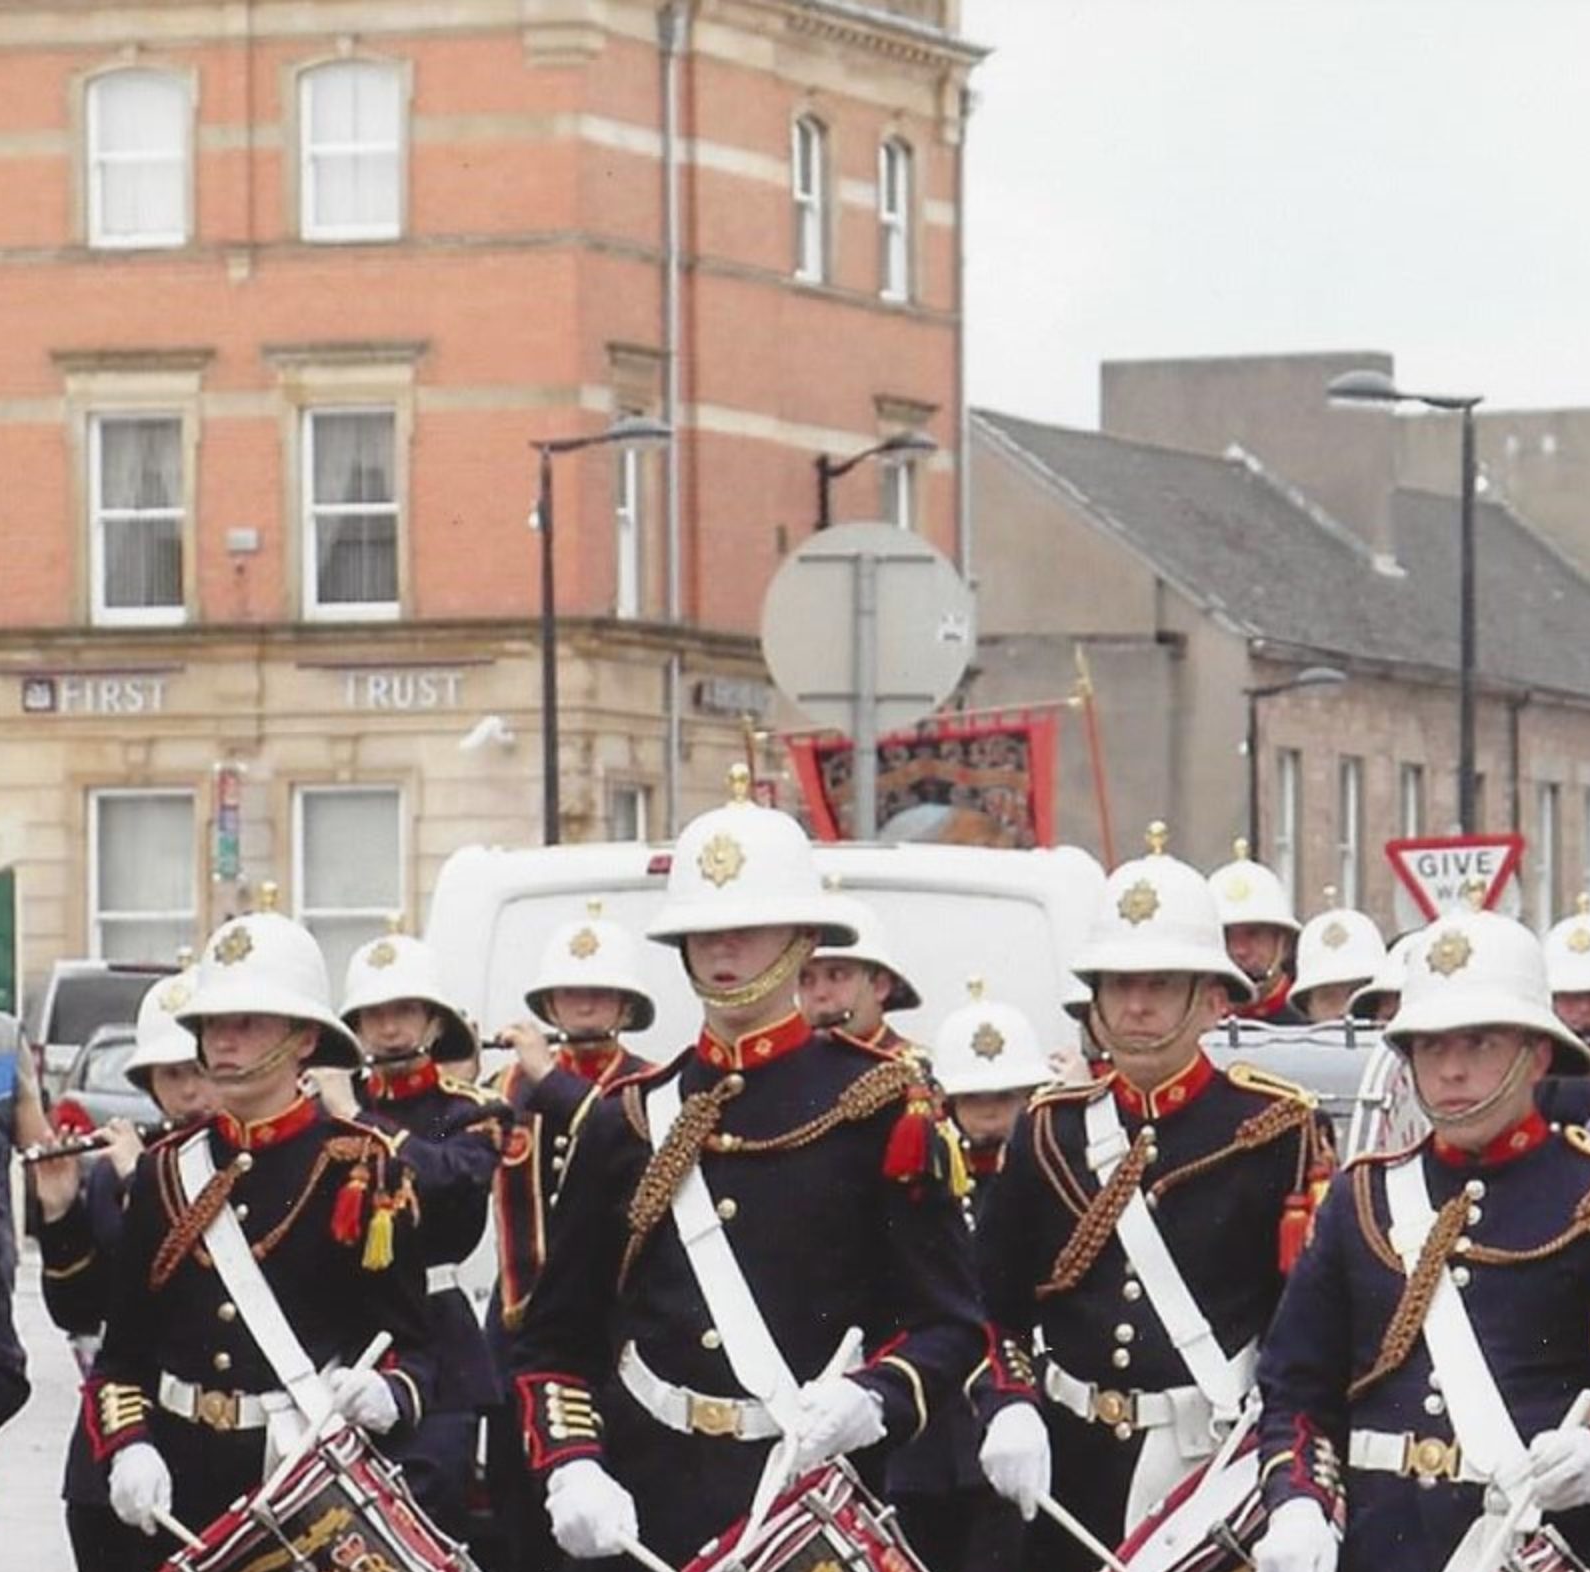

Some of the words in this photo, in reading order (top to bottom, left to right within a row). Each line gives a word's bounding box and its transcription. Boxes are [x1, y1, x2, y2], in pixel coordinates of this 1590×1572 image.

[59, 677, 167, 712] FIRST
[342, 671, 466, 709] TRUST
[1418, 851, 1493, 878] GIVE
